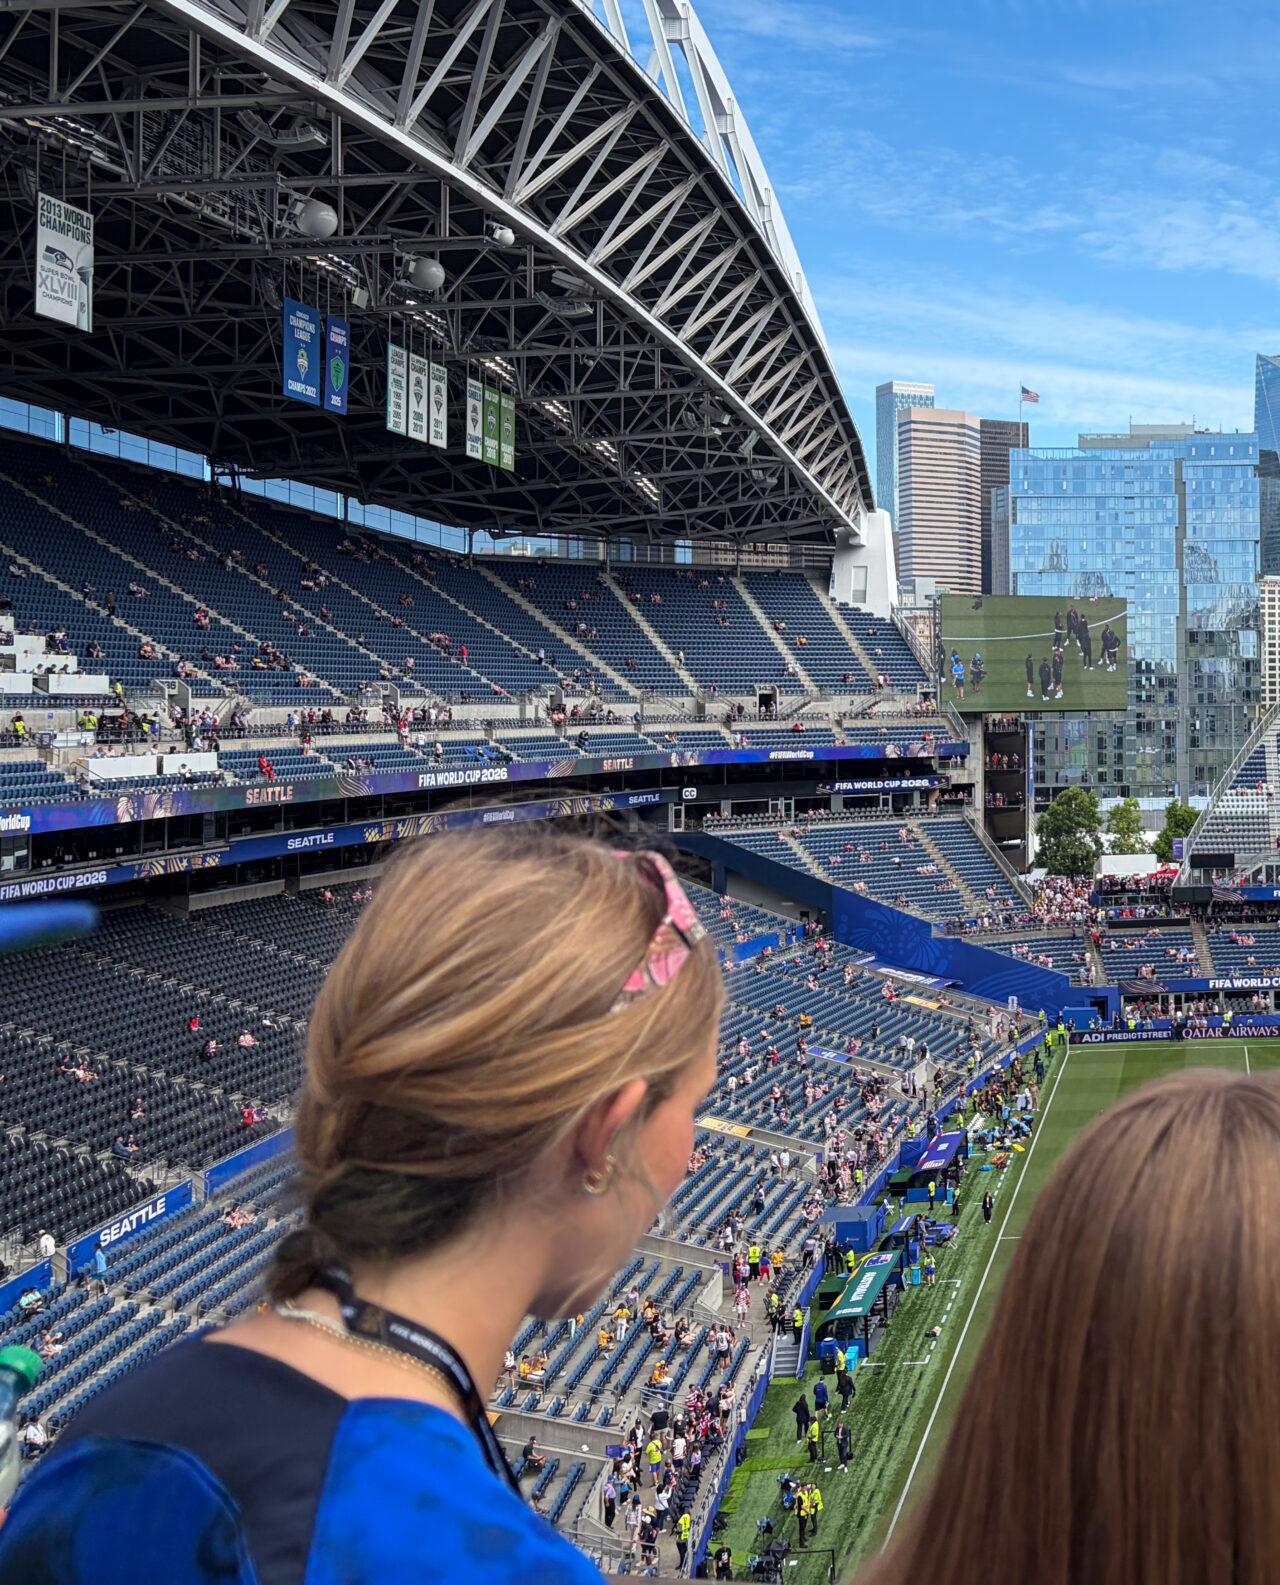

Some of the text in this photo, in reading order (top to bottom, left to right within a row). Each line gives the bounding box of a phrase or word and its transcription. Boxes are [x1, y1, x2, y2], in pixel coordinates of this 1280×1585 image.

[40, 197, 92, 231] 2013 WORLD
[40, 212, 92, 245] CHAMPIONS
[40, 264, 75, 283] SUPER BOWL
[38, 271, 78, 301] XLVIII
[42, 291, 73, 307] CHAMPIONS
[289, 315, 316, 334] CHAMPIONS
[294, 328, 311, 343] LEAGUE
[330, 331, 347, 347] CHAMPS
[391, 348, 405, 360] LEAGUE
[390, 356, 405, 369] CHAMPS
[411, 363, 427, 377] CHAMPS
[288, 379, 317, 398] CHAMPS 2022
[769, 750, 814, 760] #FIFAWorldCup
[603, 757, 634, 771] SEATTLE
[418, 768, 508, 788] FIFA WORLD CUP 2026
[835, 779, 929, 791] FIFA WORLD CUP 2026
[246, 785, 293, 805] SEATTLE
[628, 792, 660, 805] SEATTLE
[684, 789, 696, 798] CC
[0, 814, 30, 831] orldCup
[287, 833, 334, 849] SEATTLE
[0, 870, 107, 899] FIFA WORLD CUP 2026
[1209, 979, 1231, 989] FIFA
[1233, 978, 1270, 988] WORLD
[1082, 1032, 1105, 1043] ADI
[1182, 1026, 1279, 1040] QATAR AIRWAYS
[100, 1197, 166, 1247] SEATTLE
